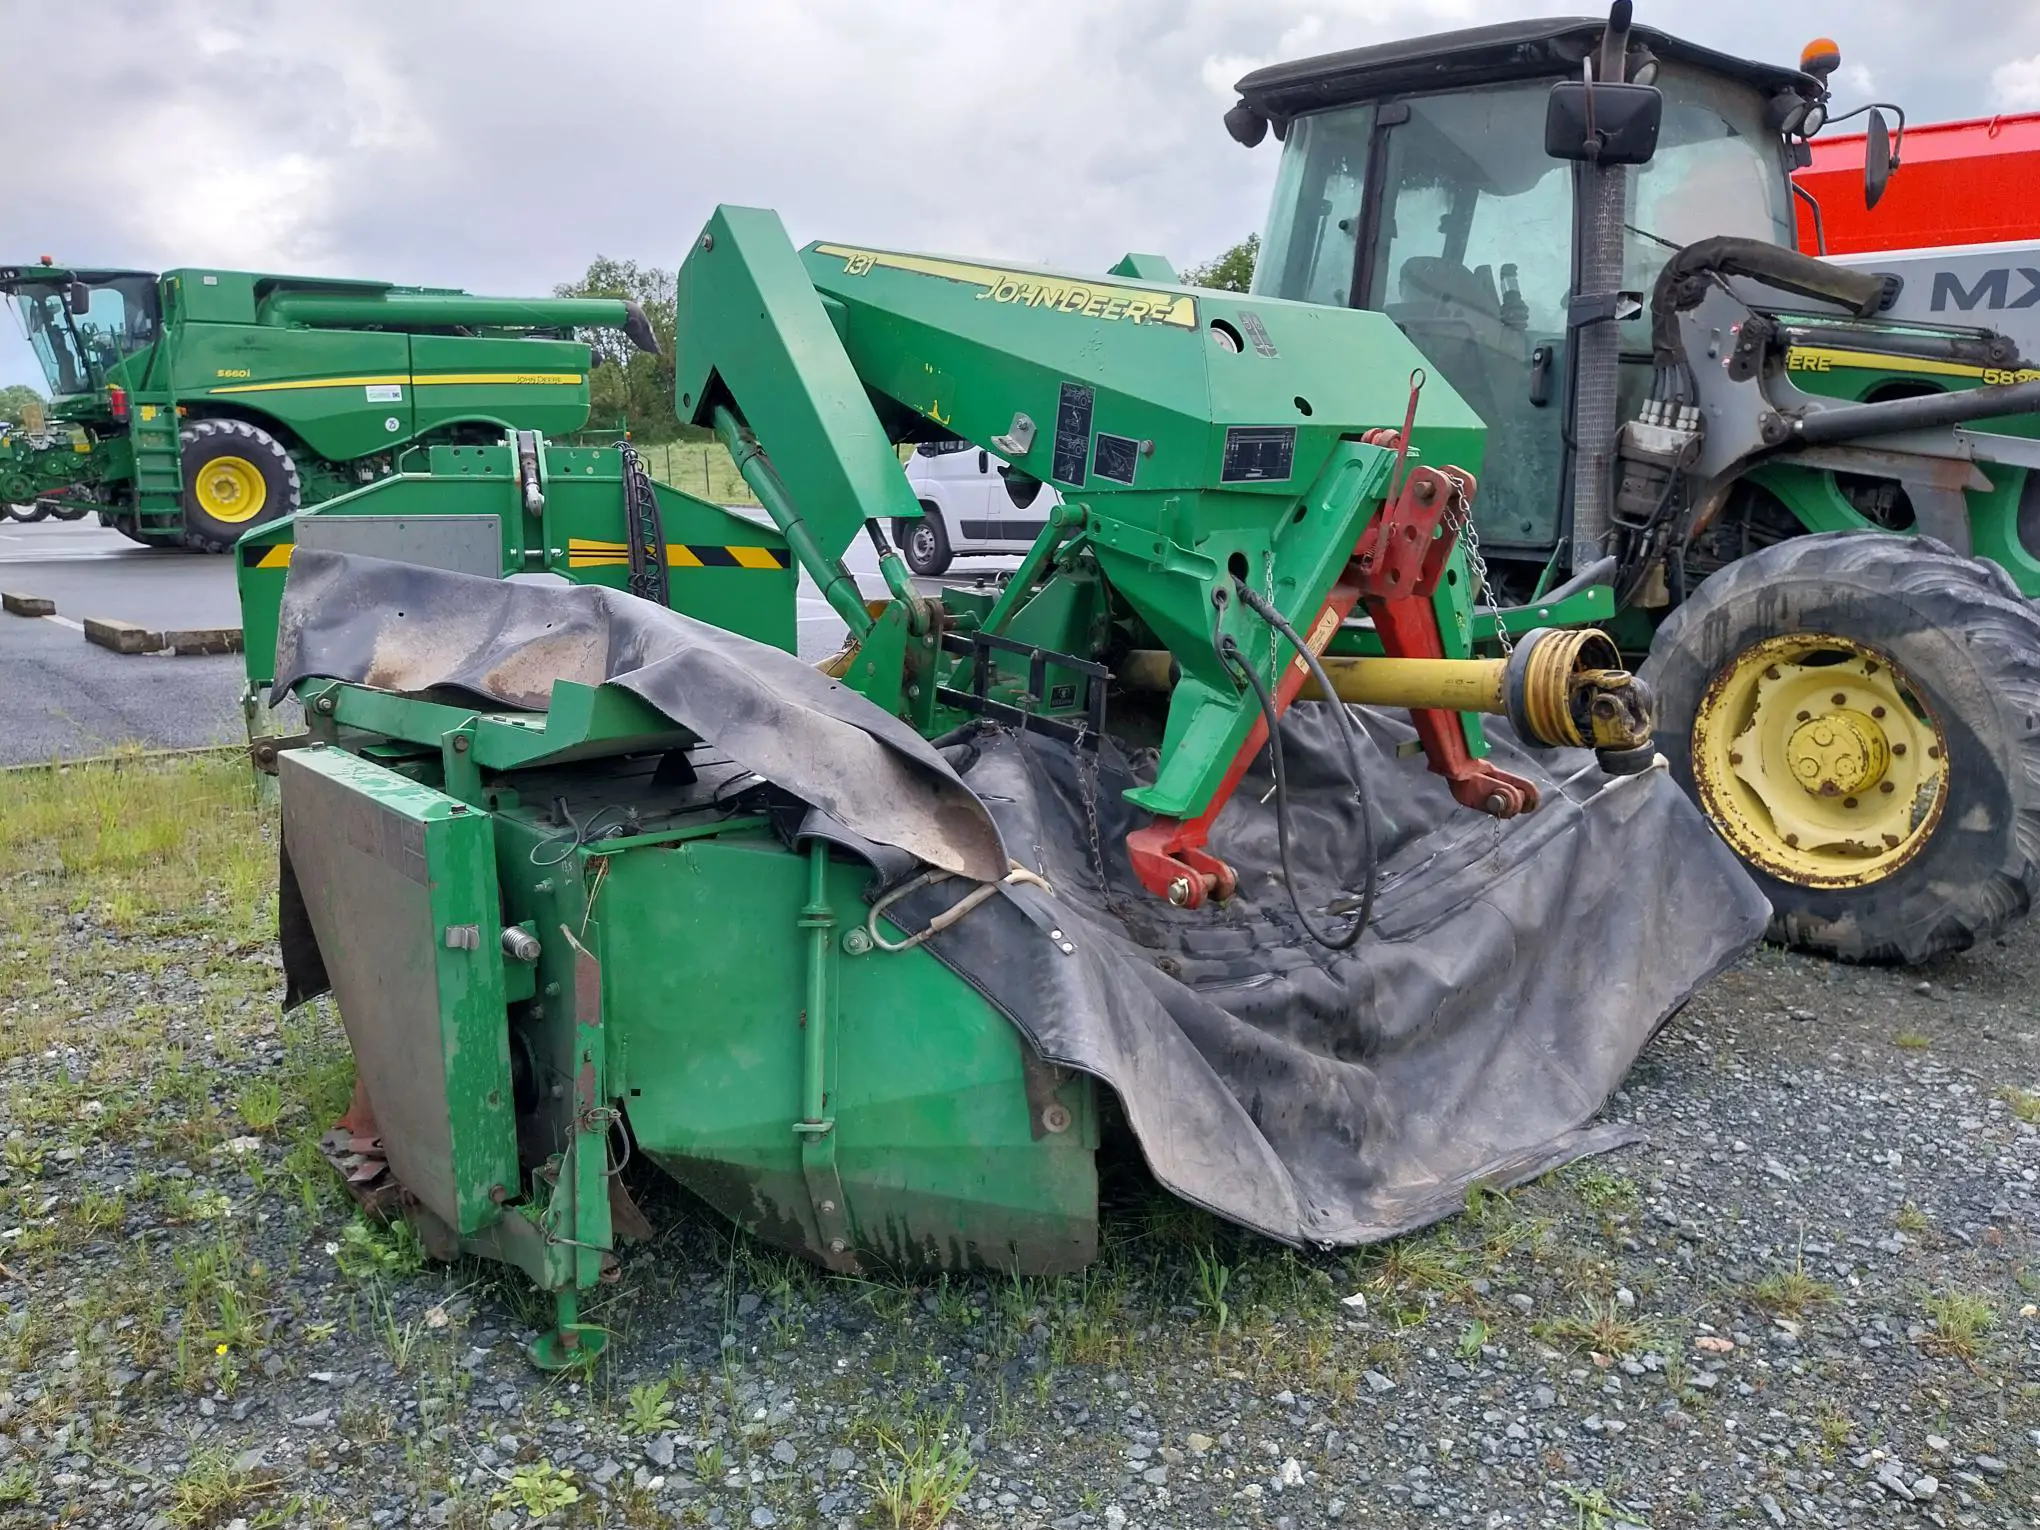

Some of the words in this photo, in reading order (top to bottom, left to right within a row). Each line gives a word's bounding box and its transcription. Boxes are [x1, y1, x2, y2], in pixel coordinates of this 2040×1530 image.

[843, 254, 878, 277] 131
[975, 275, 1064, 308] JOHN
[1056, 286, 1174, 326] DEERE
[1786, 353, 1832, 373] ERE
[516, 375, 536, 385] JOHN
[537, 375, 564, 385] DEERE
